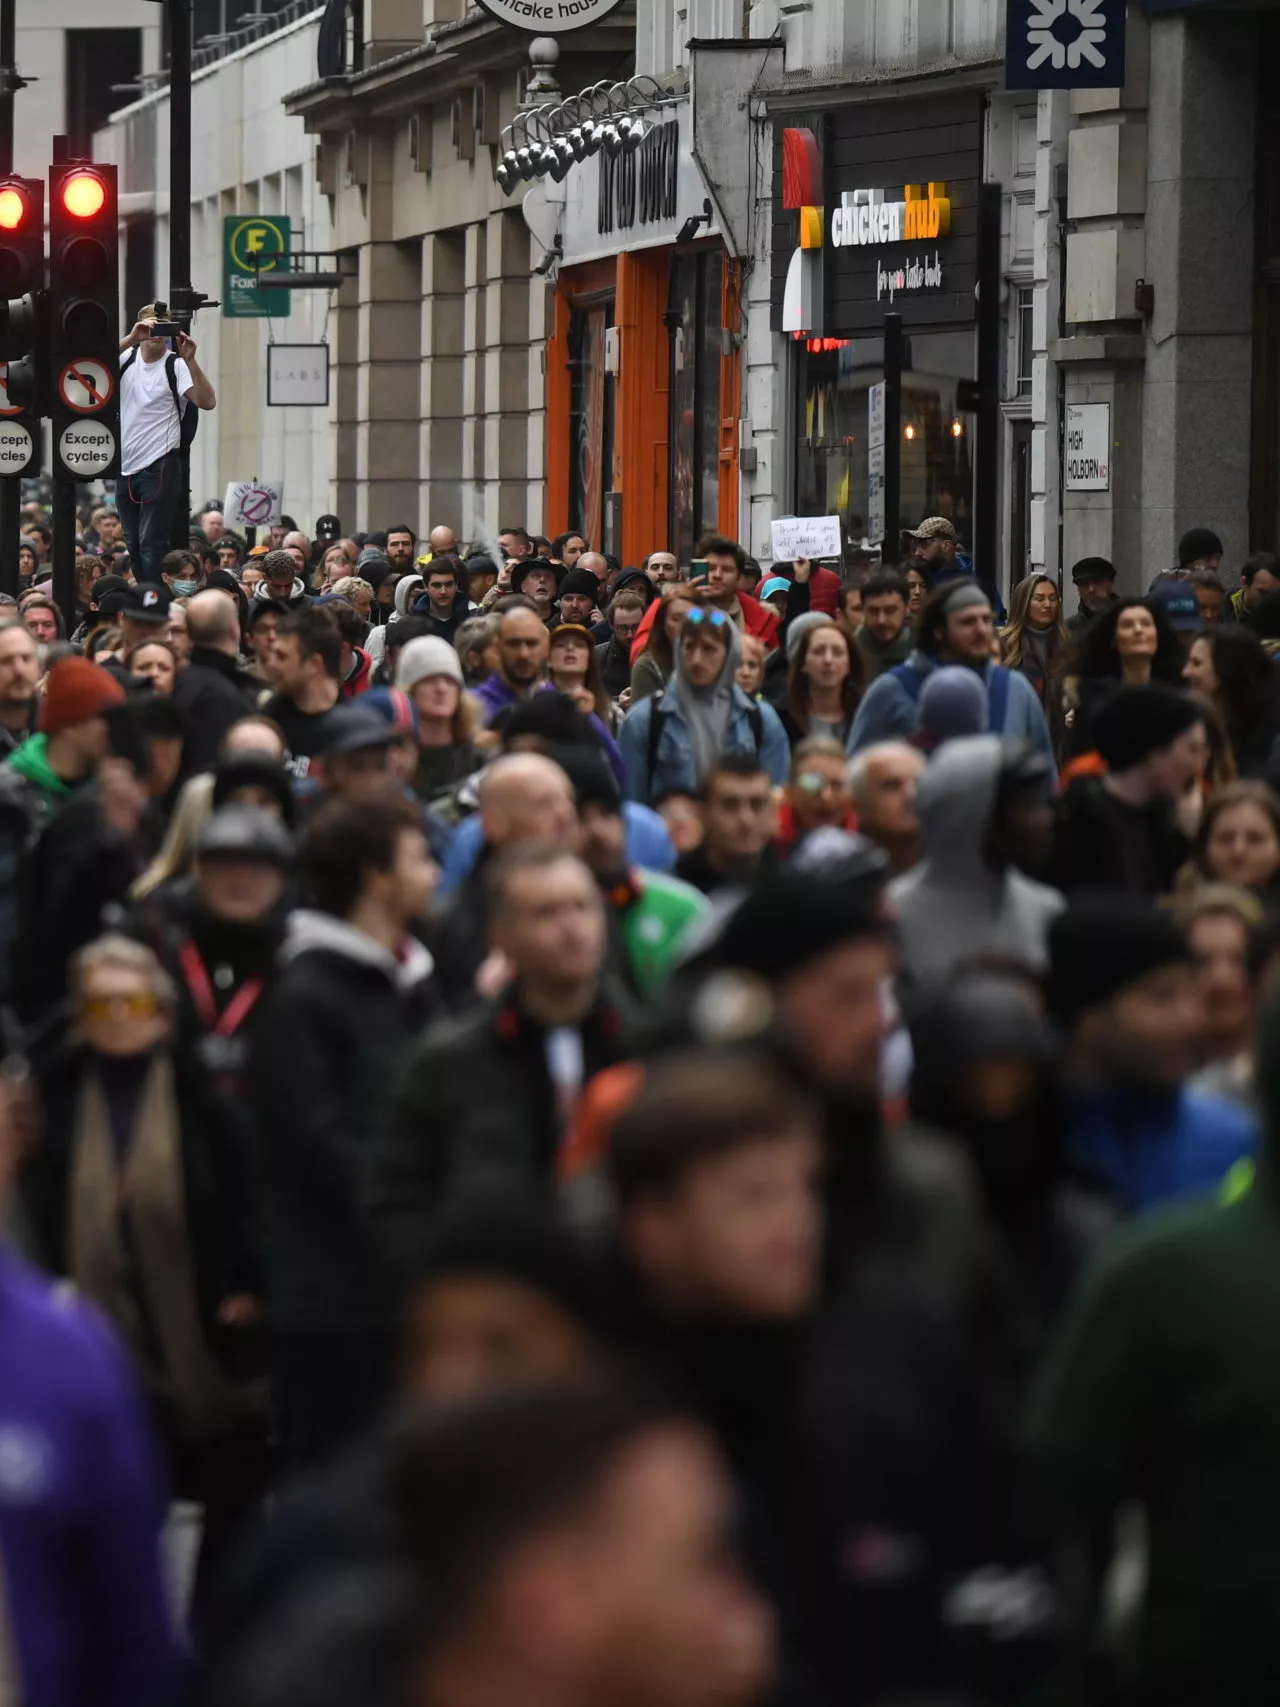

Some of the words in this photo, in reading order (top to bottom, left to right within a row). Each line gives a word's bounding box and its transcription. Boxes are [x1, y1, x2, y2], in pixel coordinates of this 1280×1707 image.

[497, 0, 553, 19] ncake
[558, 0, 599, 18] hous
[639, 119, 679, 225] DUTCH
[832, 188, 904, 248] chicken
[904, 182, 951, 240] hub
[230, 274, 258, 289] Fox
[275, 369, 321, 381] LABS
[65, 433, 110, 446] Except
[1068, 430, 1083, 450] HIGH
[66, 451, 108, 463] cycles
[1068, 459, 1099, 479] HOLBORN
